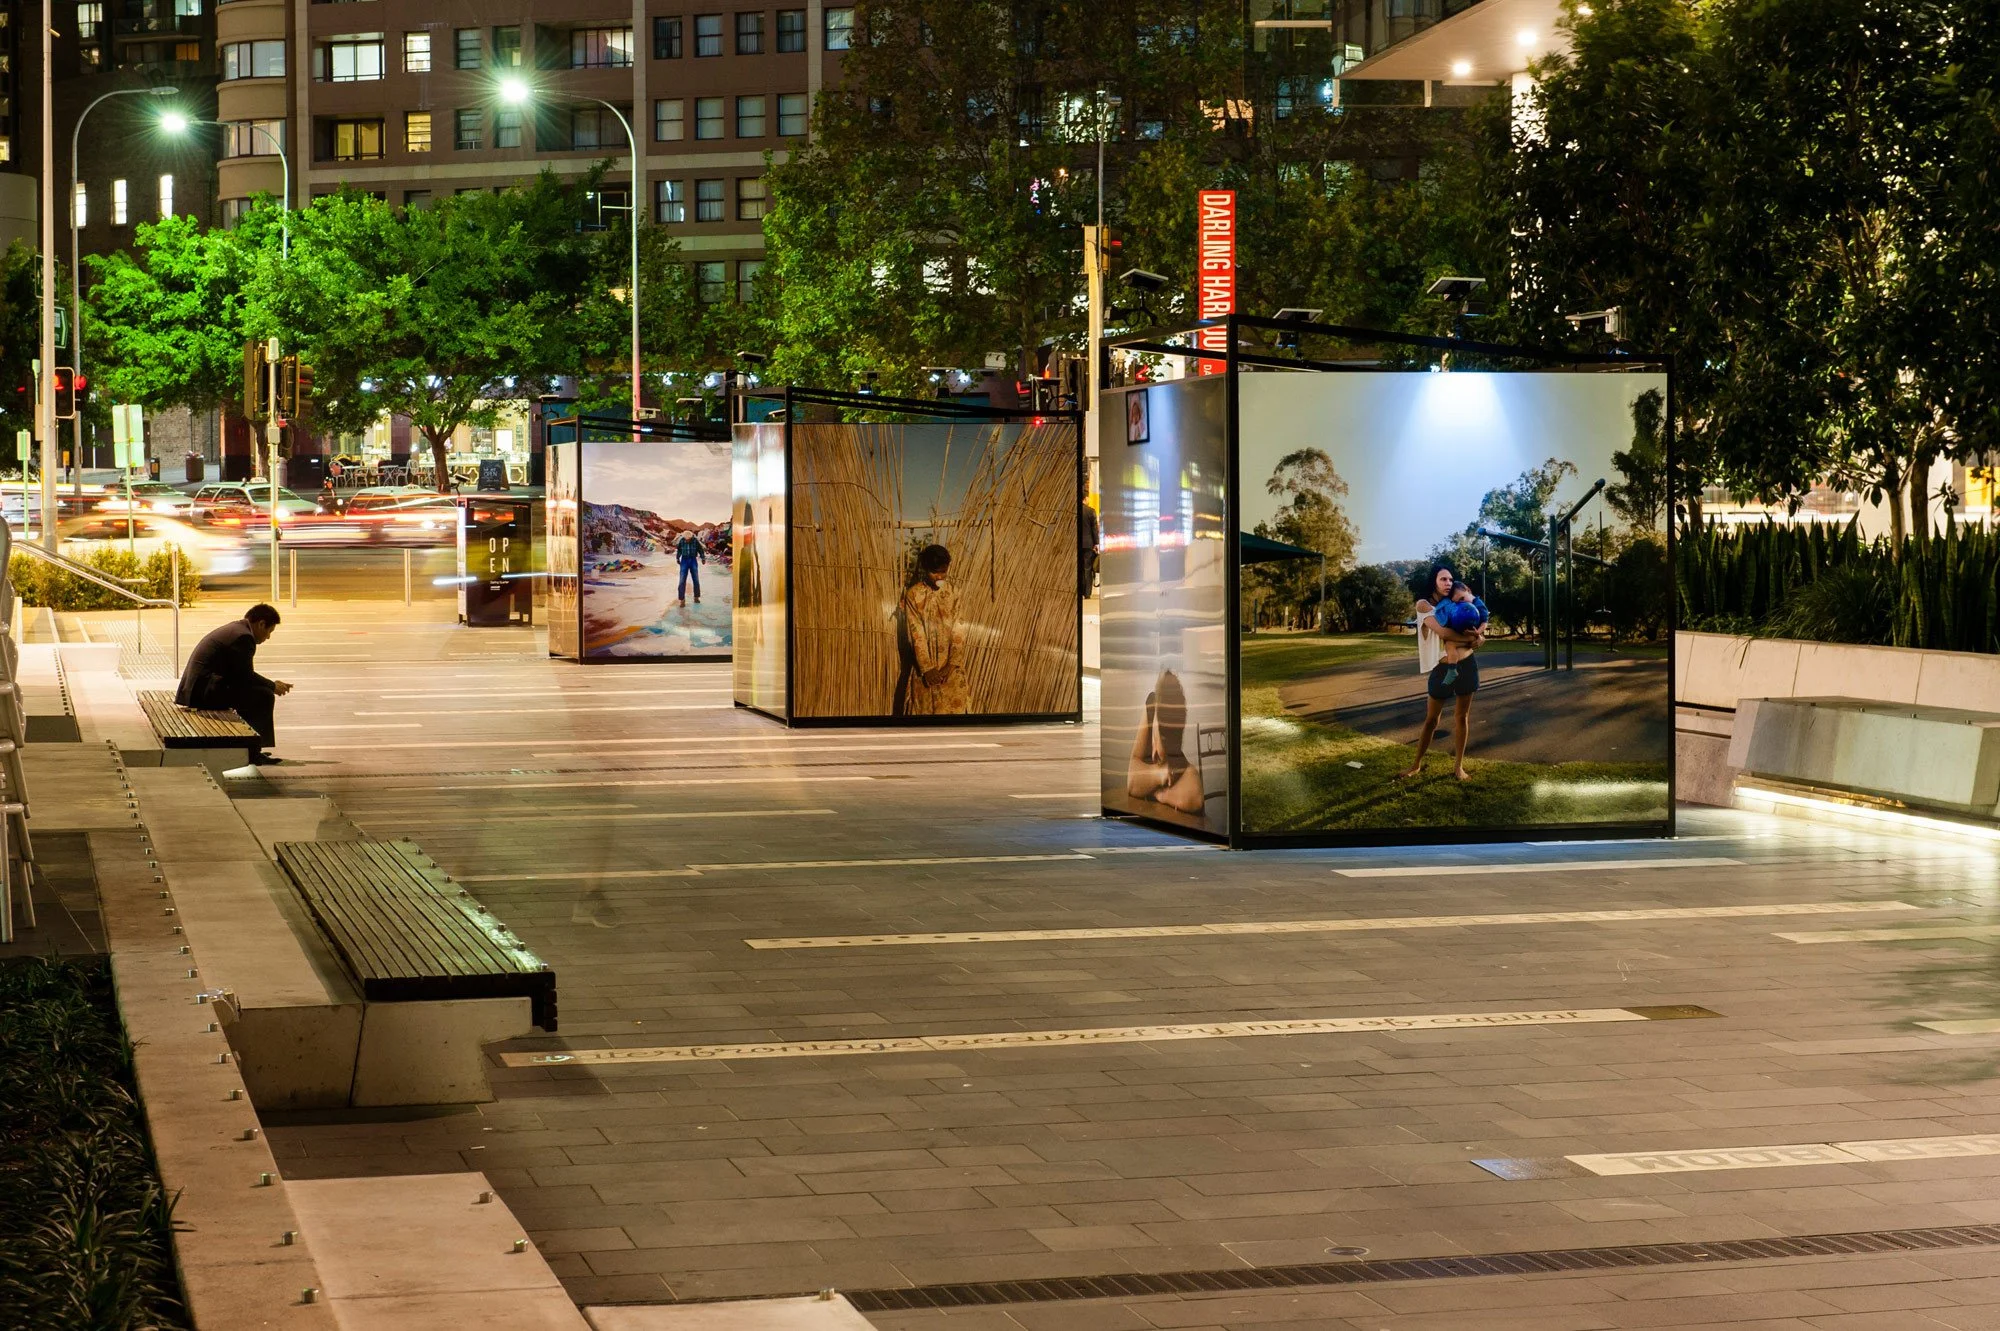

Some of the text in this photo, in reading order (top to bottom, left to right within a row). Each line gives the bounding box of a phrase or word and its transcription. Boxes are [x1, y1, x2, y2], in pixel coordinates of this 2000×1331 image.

[1203, 194, 1231, 352] DARLING HAROU
[1157, 1026, 1235, 1036] by
[1247, 1021, 1348, 1032] men
[1358, 1017, 1420, 1028] of
[1430, 1010, 1592, 1025] capital
[1604, 1149, 1833, 1170] BOOM
